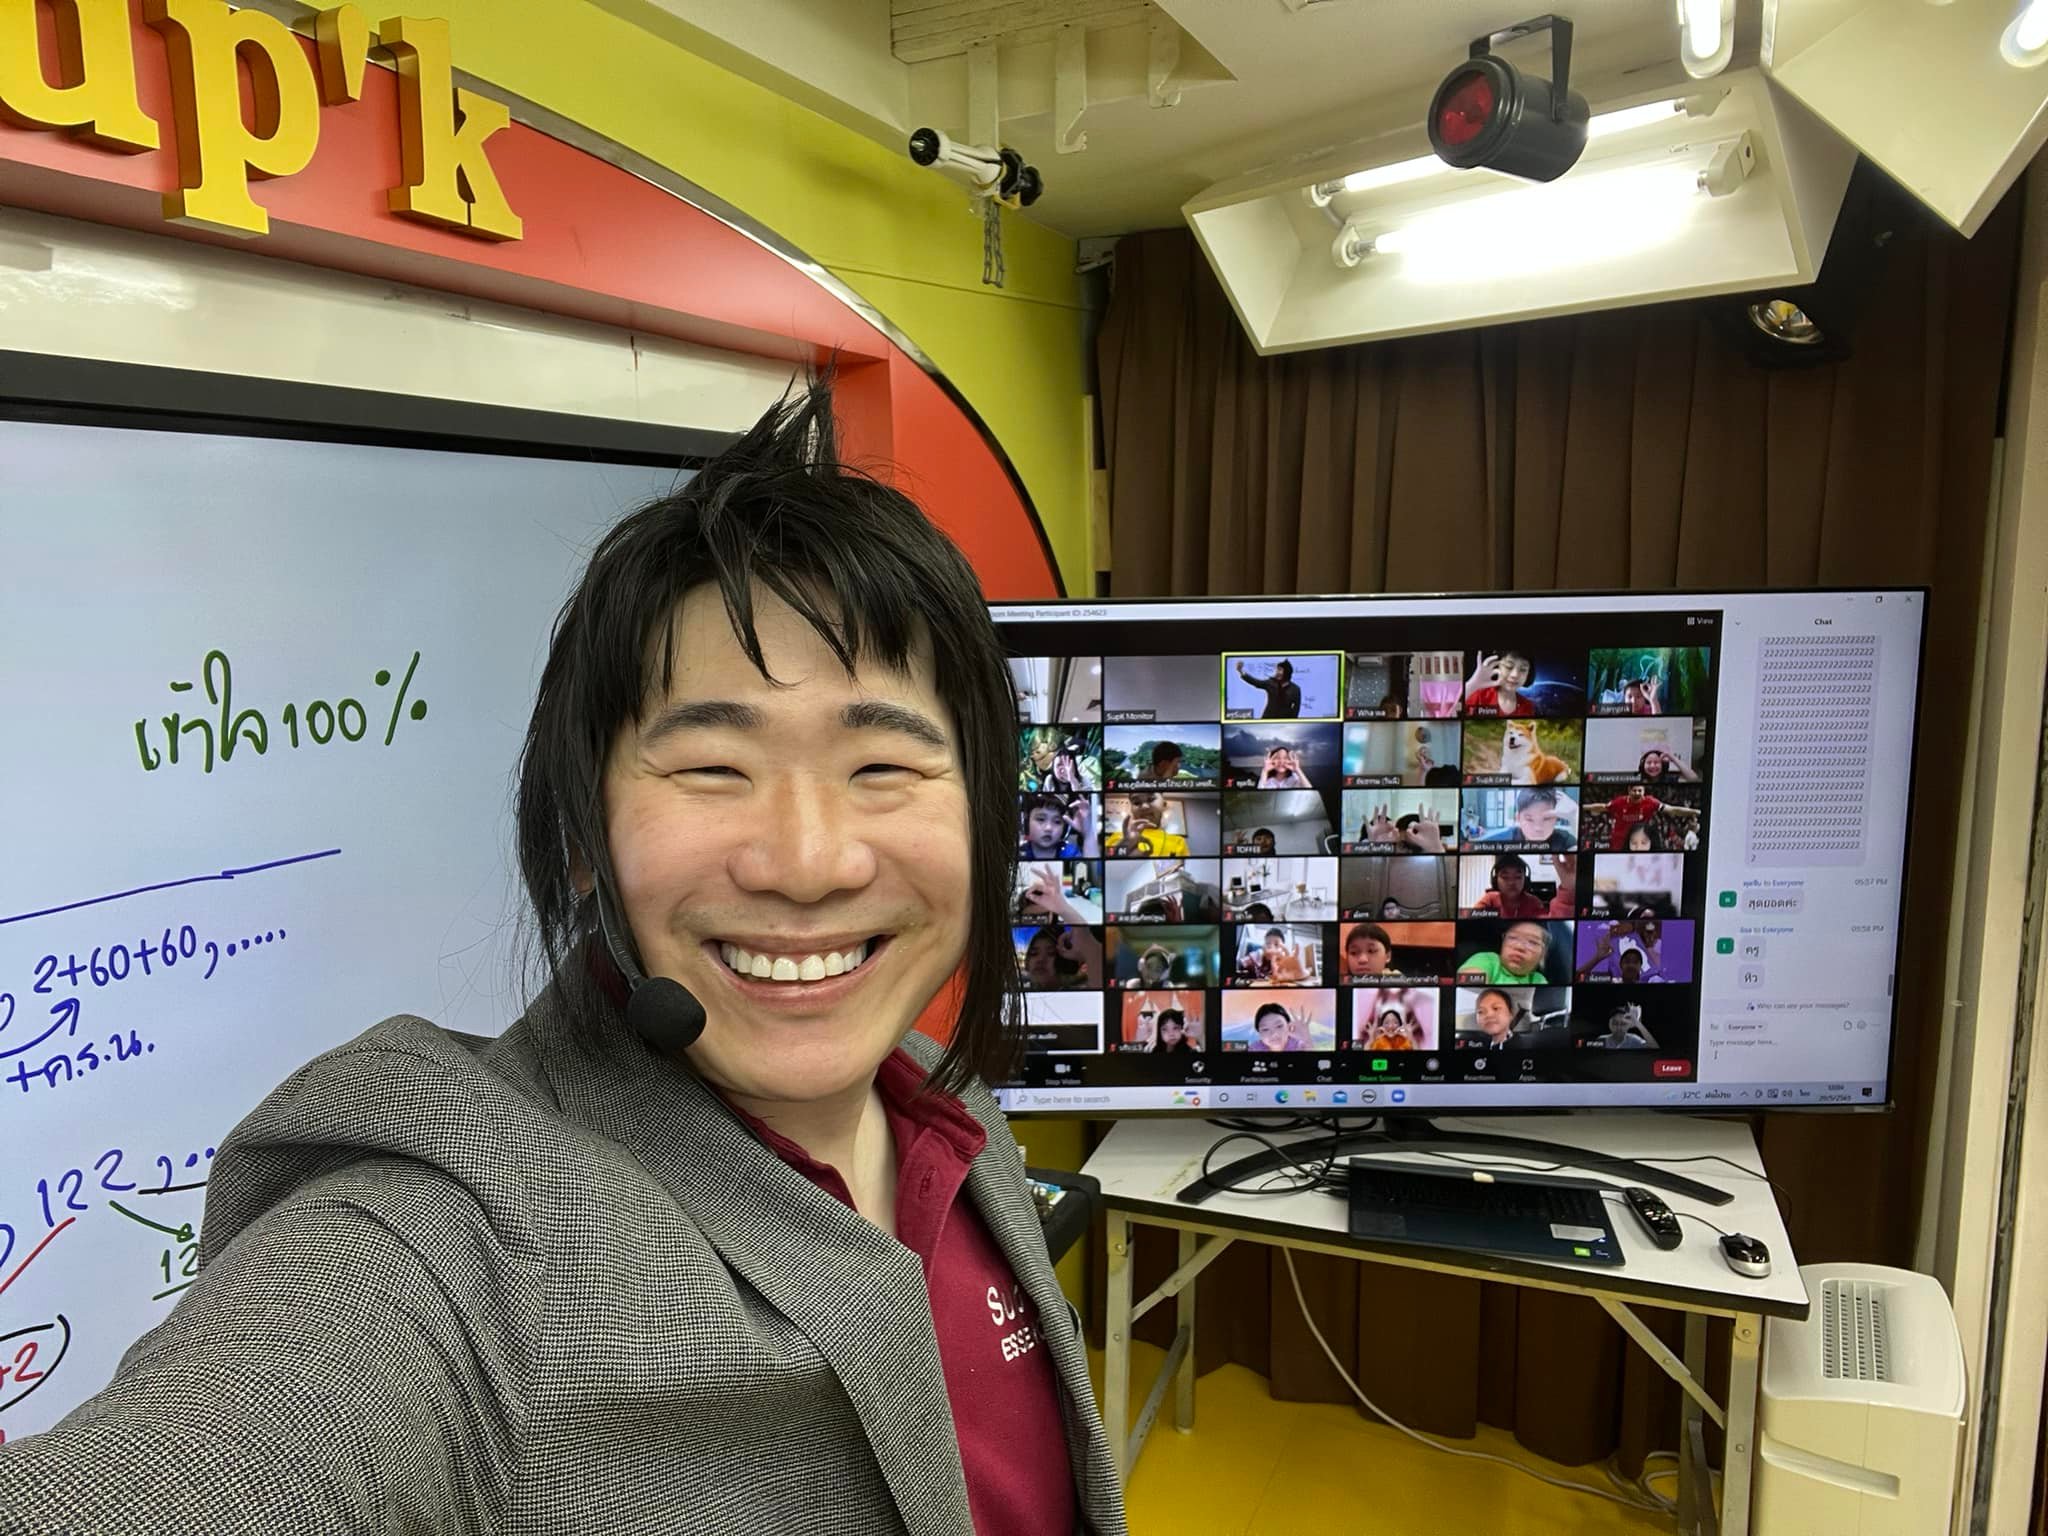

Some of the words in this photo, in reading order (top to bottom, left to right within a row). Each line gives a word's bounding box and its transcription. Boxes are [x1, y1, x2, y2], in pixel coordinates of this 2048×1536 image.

[1007, 610, 1034, 619] Meeting
[1036, 610, 1071, 619] Participant
[1697, 617, 1714, 625] View
[1814, 618, 1833, 626] Chat
[135, 649, 268, 773] เข้าใจ
[282, 651, 428, 749] 100%
[1126, 712, 1154, 721] Monitor
[1236, 846, 1261, 854] TOFFEE
[1502, 843, 1521, 852] good
[1530, 841, 1550, 849] math
[1773, 879, 1804, 888] Everyone
[1471, 909, 1498, 917] Andrew
[1591, 908, 1610, 917] Anya
[1762, 926, 1794, 935] Everyone
[1728, 1023, 1756, 1031] Everyone
[1662, 1064, 1682, 1073] Leave
[1033, 1096, 1052, 1105] Type
[1053, 1095, 1071, 1103] here
[1073, 1095, 1083, 1103] to
[1084, 1095, 1110, 1103] search
[987, 1285, 1024, 1326] SU
